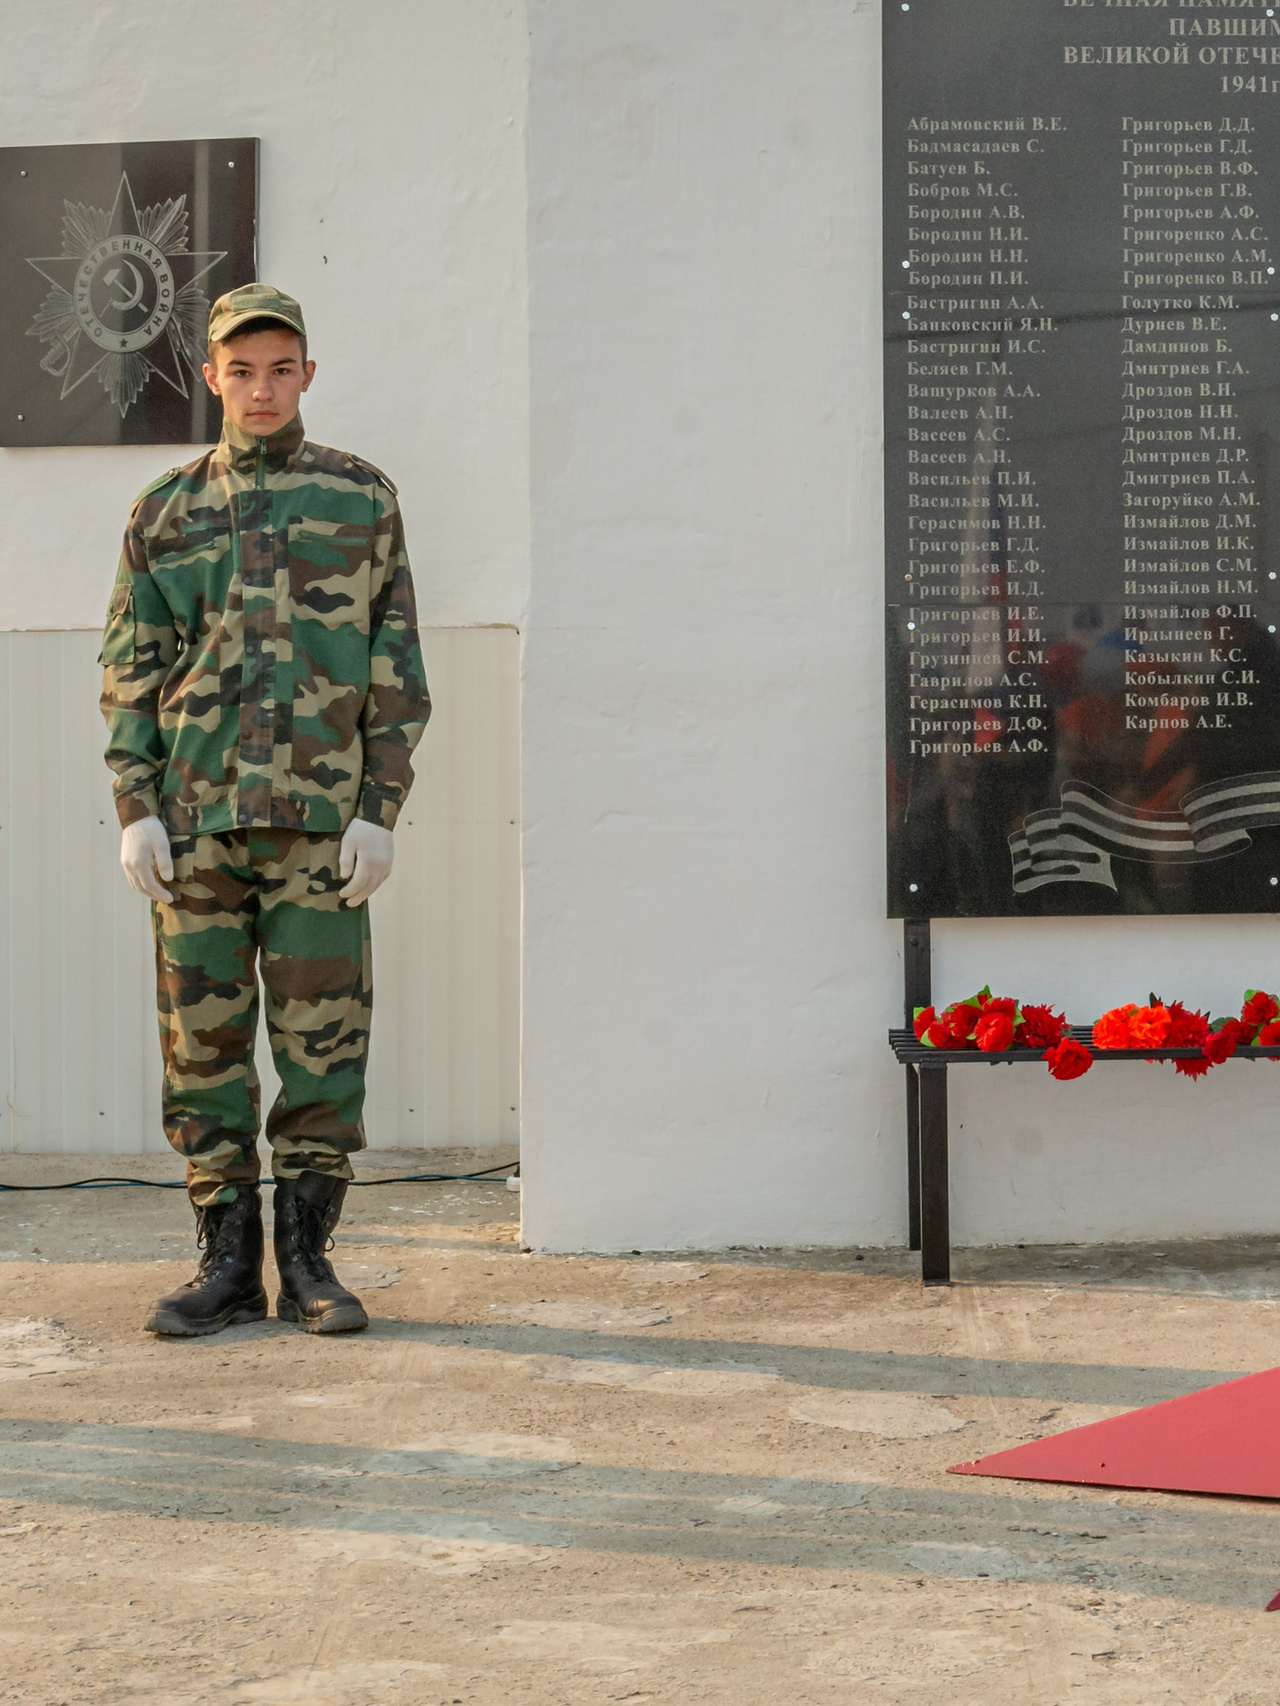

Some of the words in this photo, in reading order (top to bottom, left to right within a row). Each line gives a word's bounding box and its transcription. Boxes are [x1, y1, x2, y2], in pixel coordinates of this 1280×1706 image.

[1063, 42, 1190, 66] ВЕЛИКОЙ
[907, 117, 1025, 135] Абрамовский
[1032, 116, 1067, 131] В.Е.
[1121, 117, 1213, 135] Григорьев
[1218, 116, 1255, 134] Д.Д.
[1026, 138, 1045, 153] С.
[1122, 139, 1213, 157] Григорьев
[1219, 138, 1253, 156] Г.Д.
[907, 161, 967, 179] Батуев
[973, 160, 991, 175] Б.
[1122, 161, 1213, 179] Григорьев
[1219, 160, 1259, 175] В.Ф.
[908, 183, 970, 201] Бобров
[977, 182, 1018, 197] М.С.
[908, 205, 982, 223] Бородин
[989, 205, 1025, 220] А.В.
[1122, 205, 1214, 223] Григорьев
[1220, 204, 1260, 219] А.Ф.
[1123, 227, 1225, 245] Григоренко
[1231, 226, 1269, 241] А.С.
[77, 239, 163, 338] ОТЕЧЕСТВЕННАЯ
[143, 273, 171, 337] ВОЙНА
[908, 271, 983, 289] Бородин
[989, 270, 1029, 285] П.И.
[907, 295, 1001, 313] Бастригин
[1007, 295, 1044, 310] А.А.
[1198, 294, 1240, 309] К.М.
[907, 339, 1001, 357] Бастригин
[1008, 339, 1046, 354] И.С.
[1121, 338, 1209, 356] Дамдинов
[1215, 338, 1233, 353] Б.
[907, 361, 969, 376] Беляев
[975, 361, 1013, 376] Г.М.
[1121, 360, 1210, 378] Дмитриев
[1216, 360, 1250, 375] Г.А.
[1003, 383, 1041, 398] А.А.
[1121, 382, 1193, 400] Дроздов
[1199, 382, 1237, 397] В.Н.
[907, 405, 969, 420] Валеев
[975, 405, 1014, 420] А.Н.
[908, 427, 967, 442] Васеев
[974, 426, 1011, 441] А.С.
[1121, 448, 1211, 466] Дмитриев
[1215, 448, 1249, 466] Д.Р.
[908, 471, 991, 486] Васильев
[997, 471, 1036, 486] П.И.
[1123, 470, 1211, 488] Дмитриев
[1217, 470, 1256, 485] П.А.
[908, 493, 991, 508] Васильев
[997, 493, 1040, 508] М.И.
[1123, 492, 1214, 510] Загоруйко
[1219, 492, 1261, 507] А.М.
[1123, 514, 1210, 529] Измайлов
[1215, 514, 1257, 532] Д.М.
[1123, 558, 1210, 573] Измайлов
[1215, 557, 1258, 572] С.М.
[1124, 605, 1211, 620] Измайлов
[1215, 604, 1258, 619] Ф.П.
[1124, 671, 1216, 686] Кобылкин
[1220, 670, 1261, 685] С.И.
[909, 694, 1003, 712] Герасимов
[1008, 694, 1048, 709] К.Н.
[1124, 692, 1210, 710] Комбаров
[1215, 692, 1254, 707] И.В.
[909, 716, 1002, 734] Григорьев
[1006, 716, 1048, 734] Д.Ф.
[1124, 715, 1190, 733] Карпов
[1195, 714, 1233, 729] А.Е.
[909, 738, 1003, 756] Григорьев
[1007, 738, 1049, 753] А.Ф.
